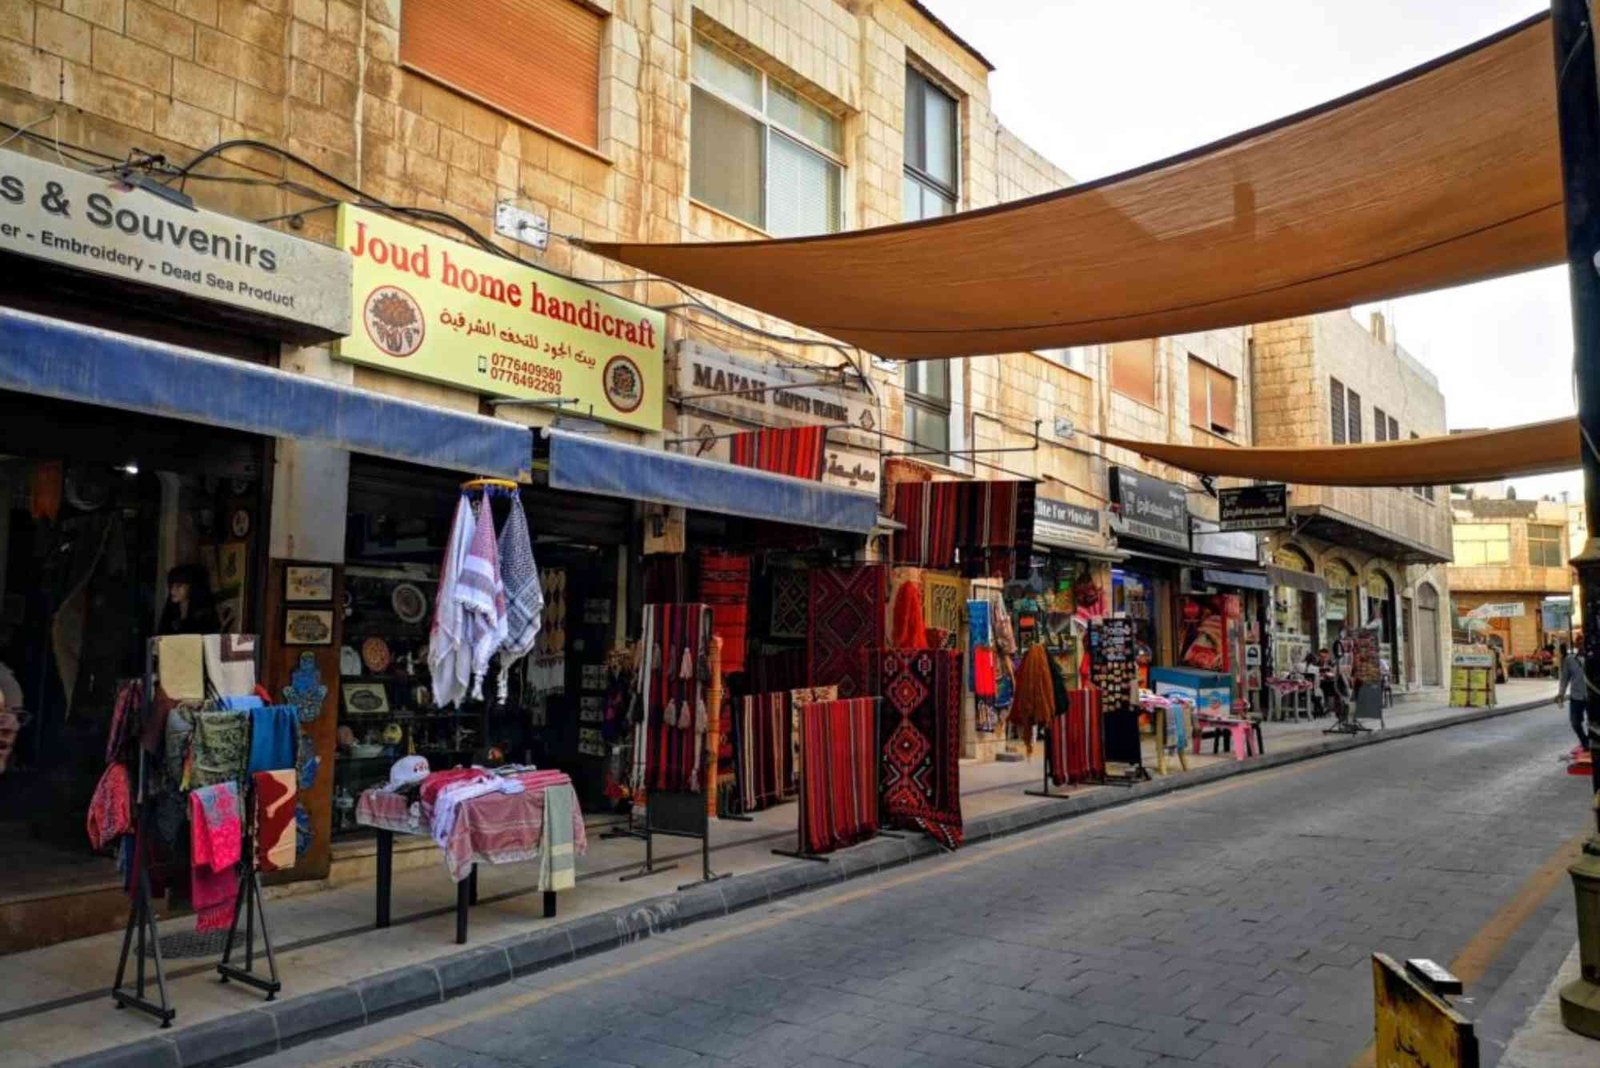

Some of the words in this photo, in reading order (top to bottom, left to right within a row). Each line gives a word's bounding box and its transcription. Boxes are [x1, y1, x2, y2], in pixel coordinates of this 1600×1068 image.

[41, 181, 70, 217] &
[86, 193, 278, 273] Souvenirs
[41, 231, 144, 271] Embroidery
[161, 261, 202, 284] Dead
[206, 272, 235, 292] Sea
[238, 282, 296, 309] Product
[350, 220, 431, 280] Joud
[441, 250, 522, 308] home
[530, 281, 657, 350] handicraft
[440, 307, 497, 336] الشرقية
[499, 327, 539, 350] للتحف
[491, 352, 563, 383] 0776409580
[573, 350, 597, 370] بيت
